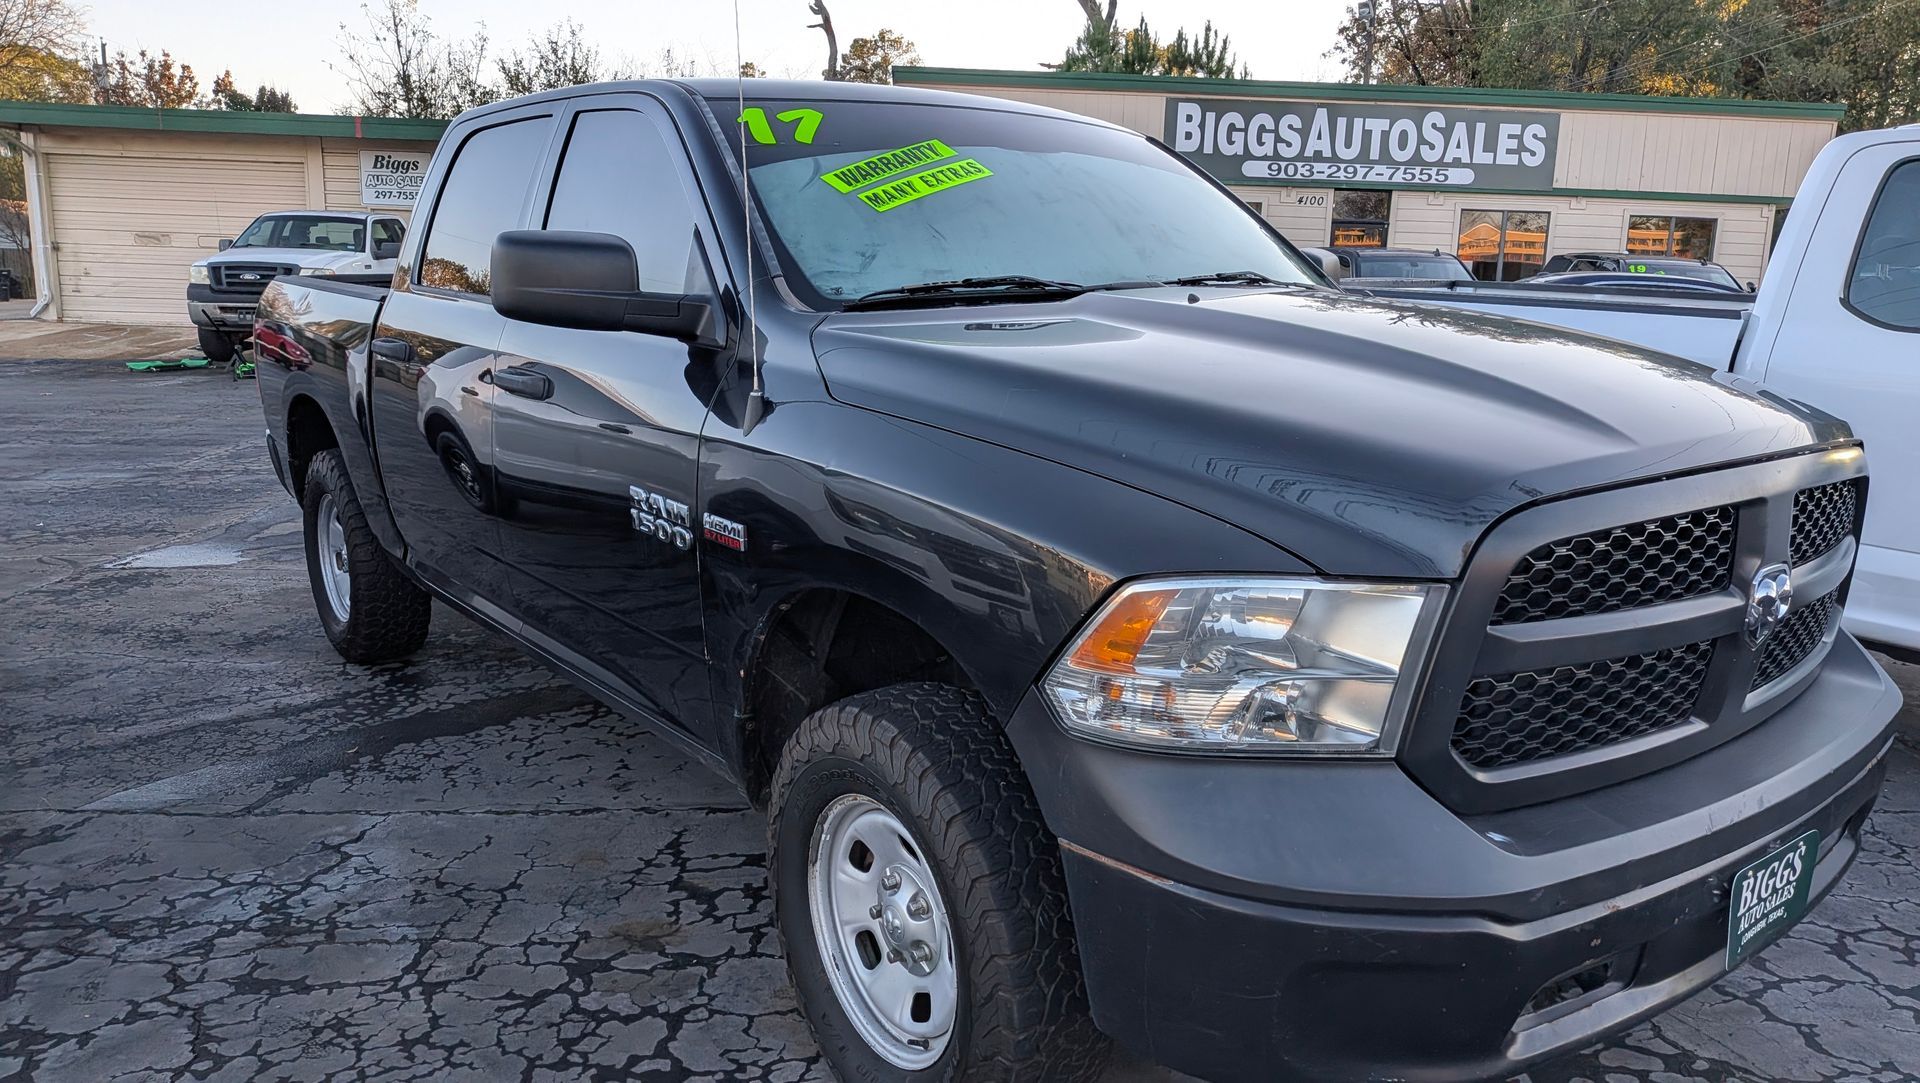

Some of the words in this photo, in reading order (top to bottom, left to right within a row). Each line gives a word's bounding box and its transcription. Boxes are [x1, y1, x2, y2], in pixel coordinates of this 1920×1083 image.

[737, 107, 823, 145] 17
[1175, 102, 1302, 158] BIGGS
[1304, 107, 1418, 162] AUTO
[1419, 111, 1547, 167] SALES
[365, 174, 396, 188] AUTO
[372, 154, 420, 175] Biggs
[833, 142, 941, 188] WARRANTY
[1267, 162, 1449, 183] 903-297-7555
[865, 180, 919, 208] MANY
[918, 160, 983, 188] EXTRAS
[1297, 195, 1325, 206] 4100
[1628, 264, 1646, 273] 19
[629, 485, 690, 527] RAM
[630, 508, 693, 550] 1500
[704, 513, 742, 538] HEMI
[717, 534, 740, 548] LITER
[1737, 845, 1806, 917] BIGGS
[1737, 901, 1764, 934] AUTO
[1764, 882, 1796, 913] SALES
